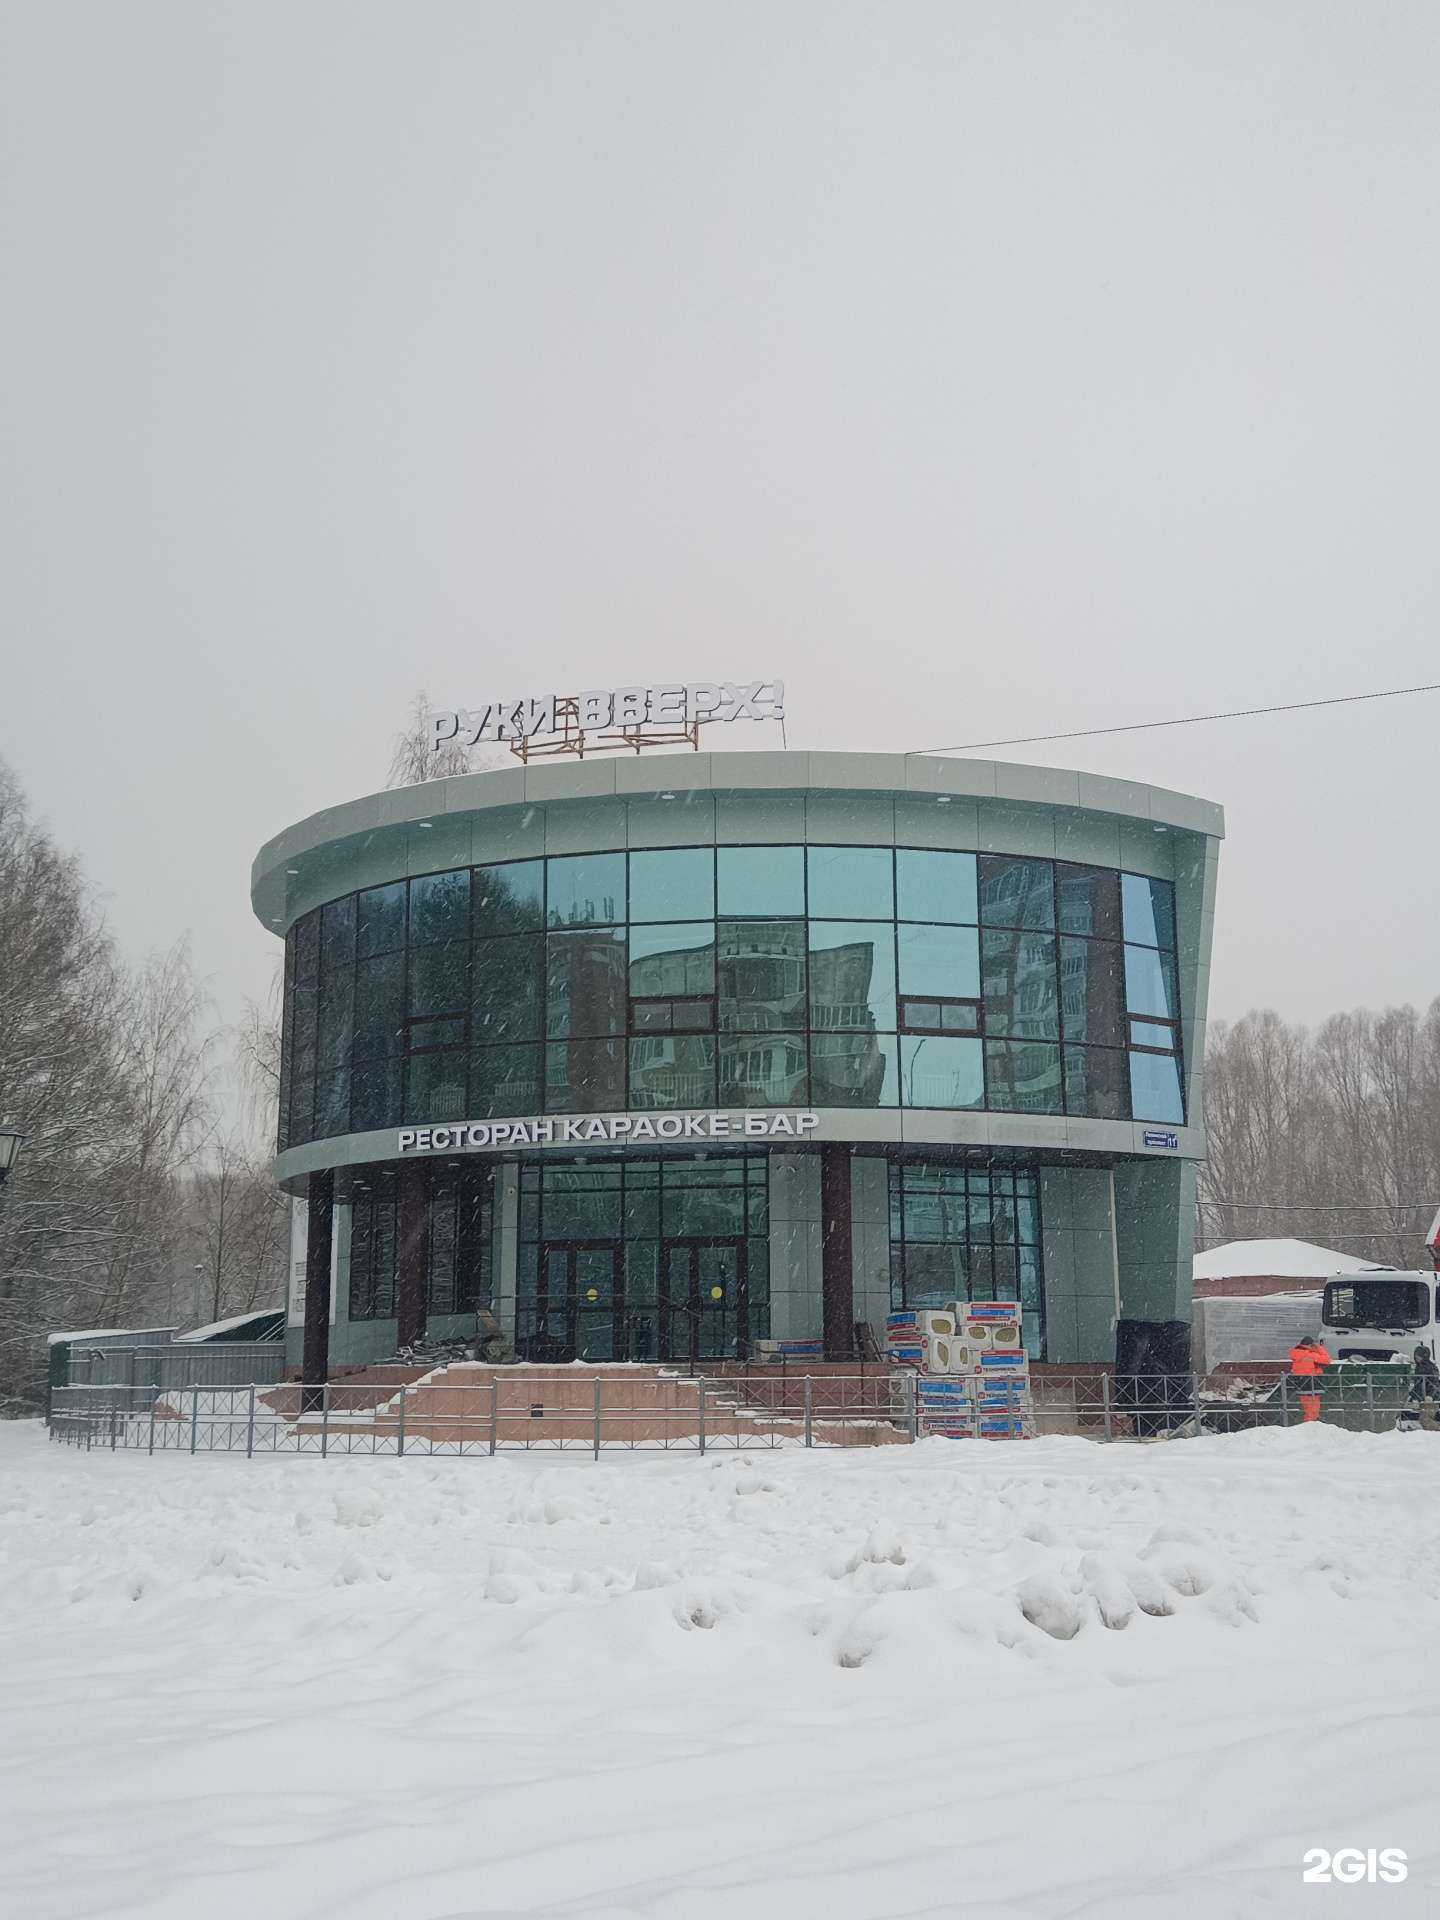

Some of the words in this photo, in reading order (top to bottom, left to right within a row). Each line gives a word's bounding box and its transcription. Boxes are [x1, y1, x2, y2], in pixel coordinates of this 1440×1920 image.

[430, 694, 557, 751] РУКИ
[579, 680, 785, 730] ВВЕРХ!
[398, 1119, 554, 1152] РЕСТОРАН
[563, 1112, 821, 1141] КАРАОКЕ-БАР
